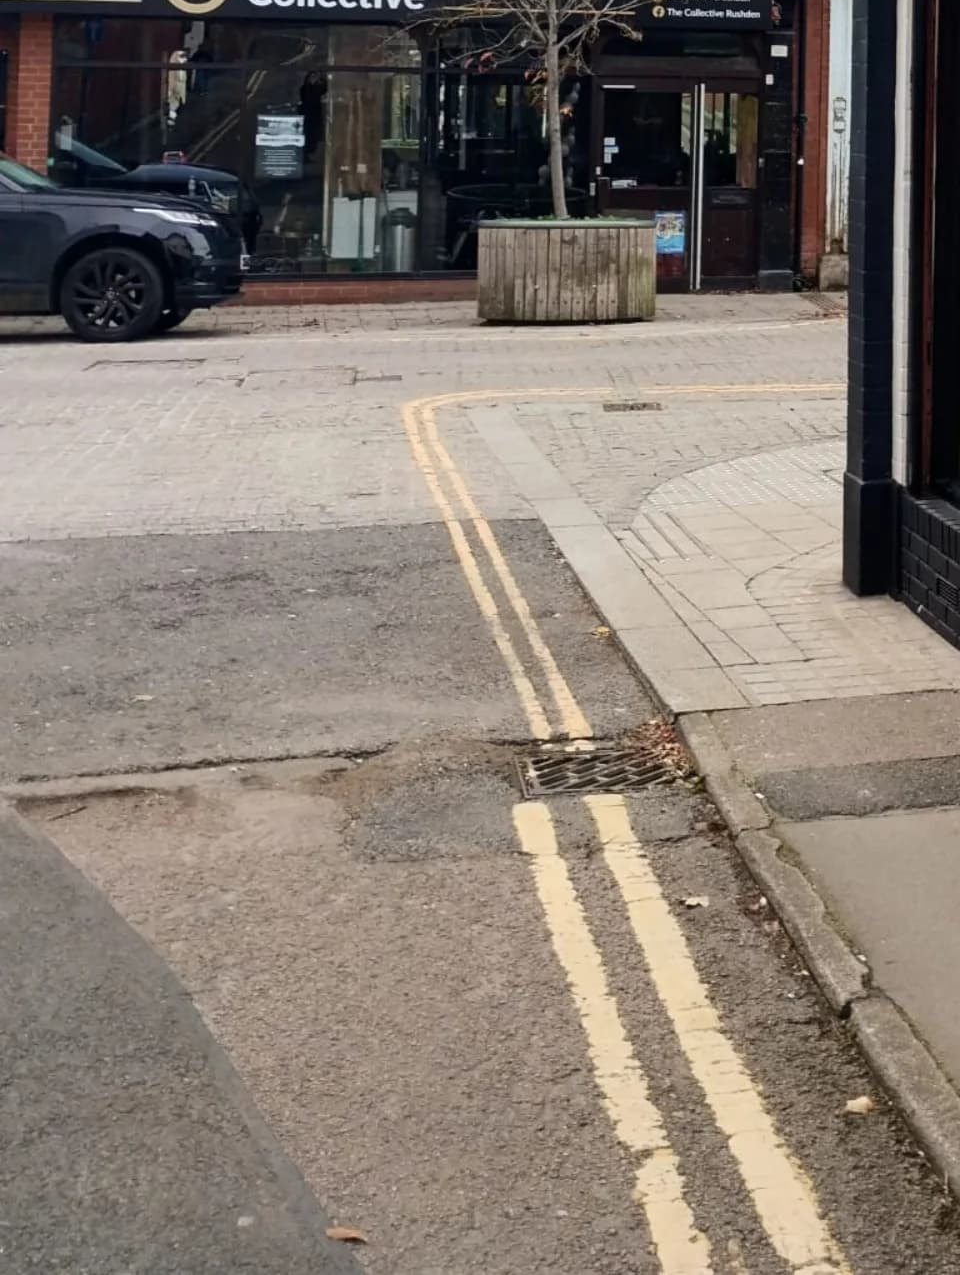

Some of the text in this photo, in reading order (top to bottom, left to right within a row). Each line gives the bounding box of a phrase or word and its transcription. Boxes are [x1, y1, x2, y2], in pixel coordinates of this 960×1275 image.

[667, 8, 682, 17] The
[684, 8, 724, 18] Collective
[726, 10, 761, 19] Rushden
